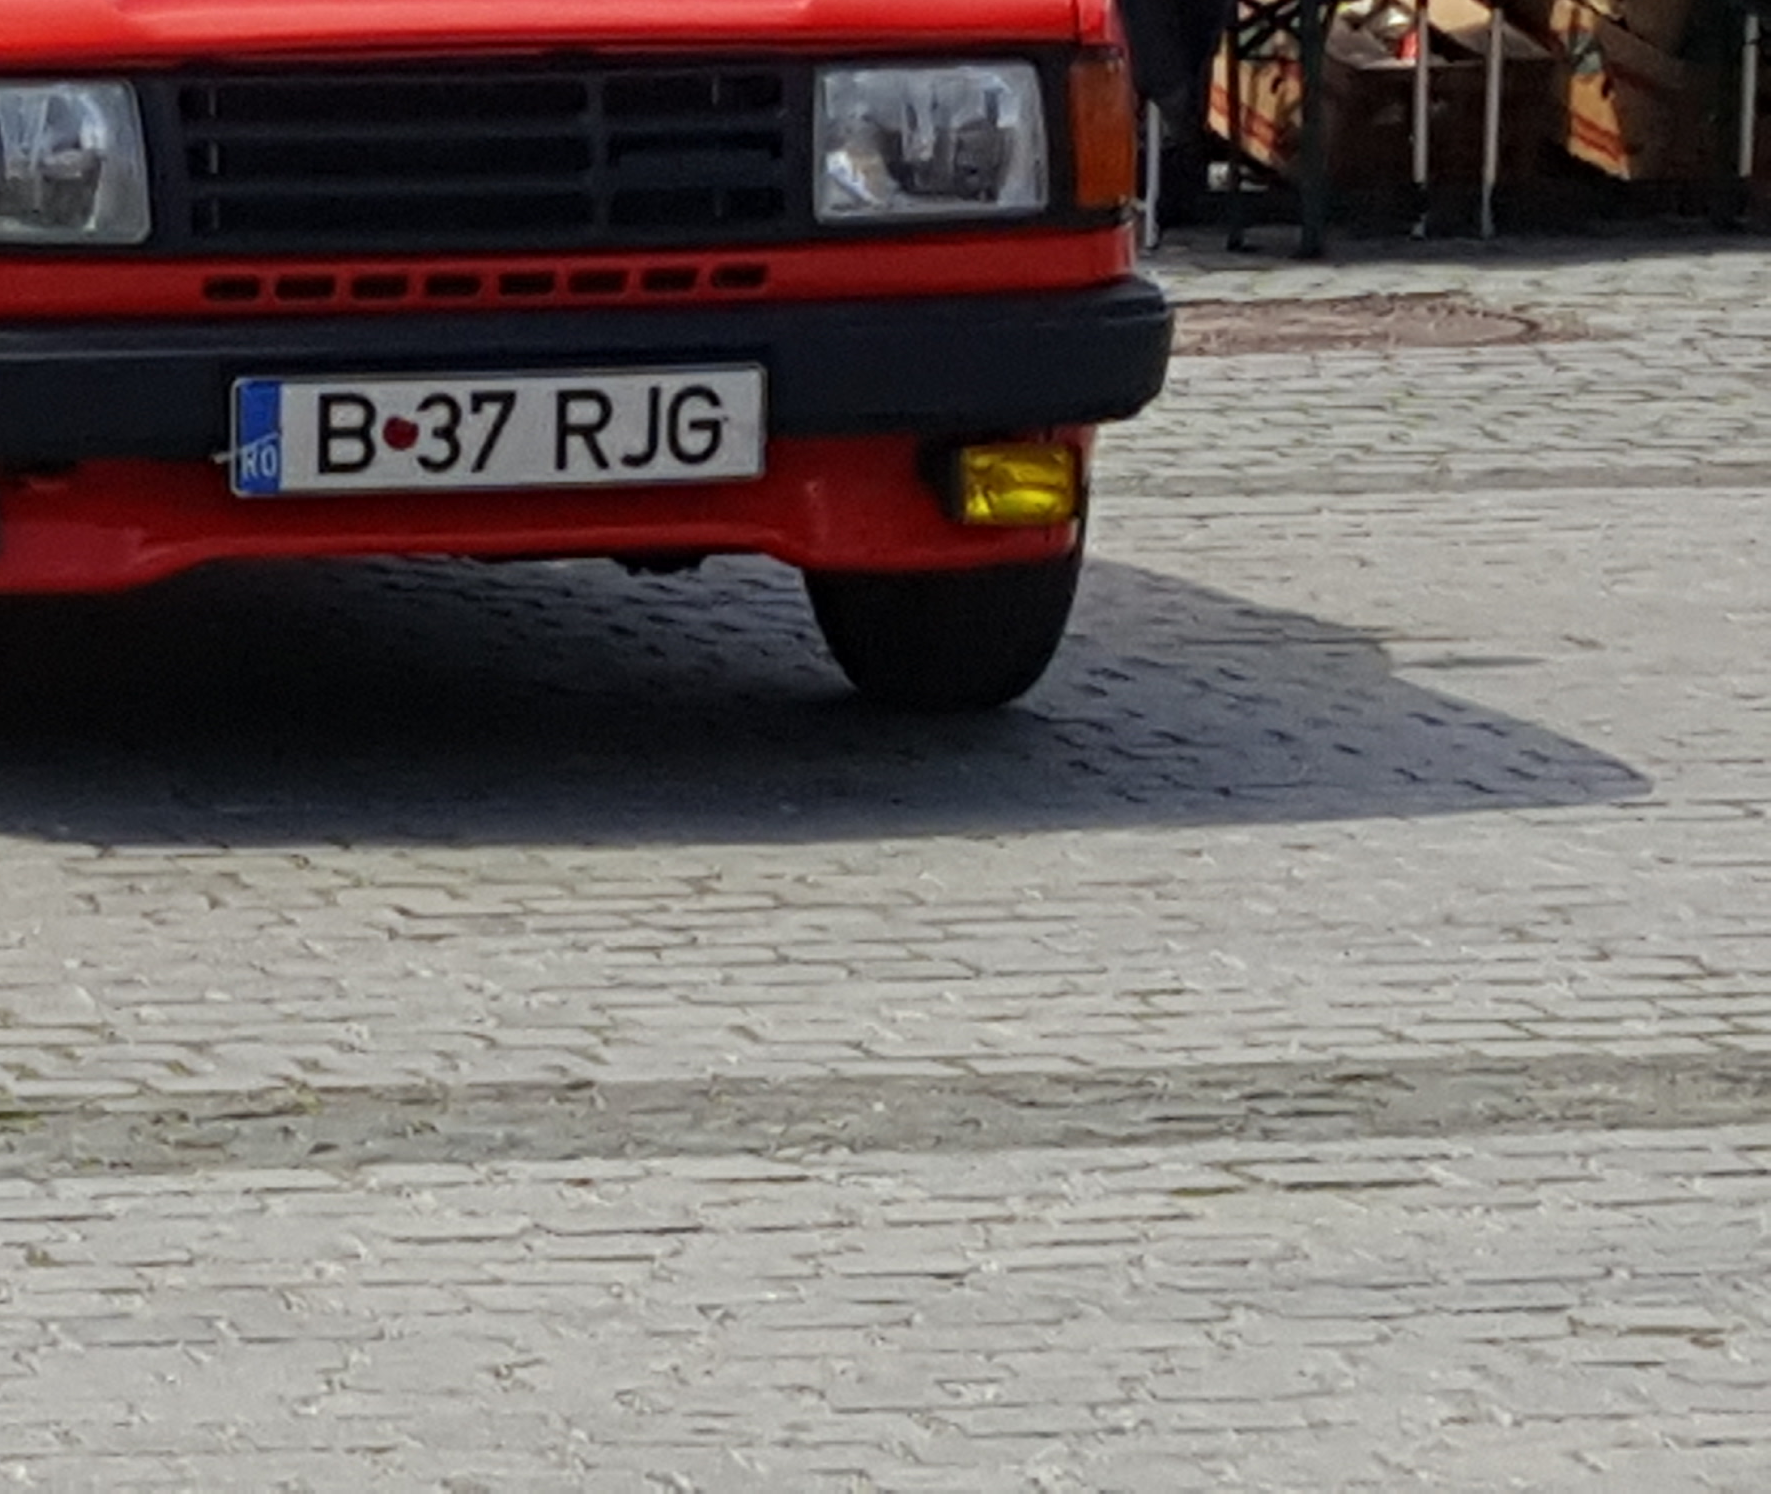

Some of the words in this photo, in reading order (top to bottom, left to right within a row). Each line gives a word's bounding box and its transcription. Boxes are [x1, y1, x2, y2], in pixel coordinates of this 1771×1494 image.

[317, 393, 376, 474] B
[416, 391, 516, 473] 37
[555, 385, 722, 470] RJG
